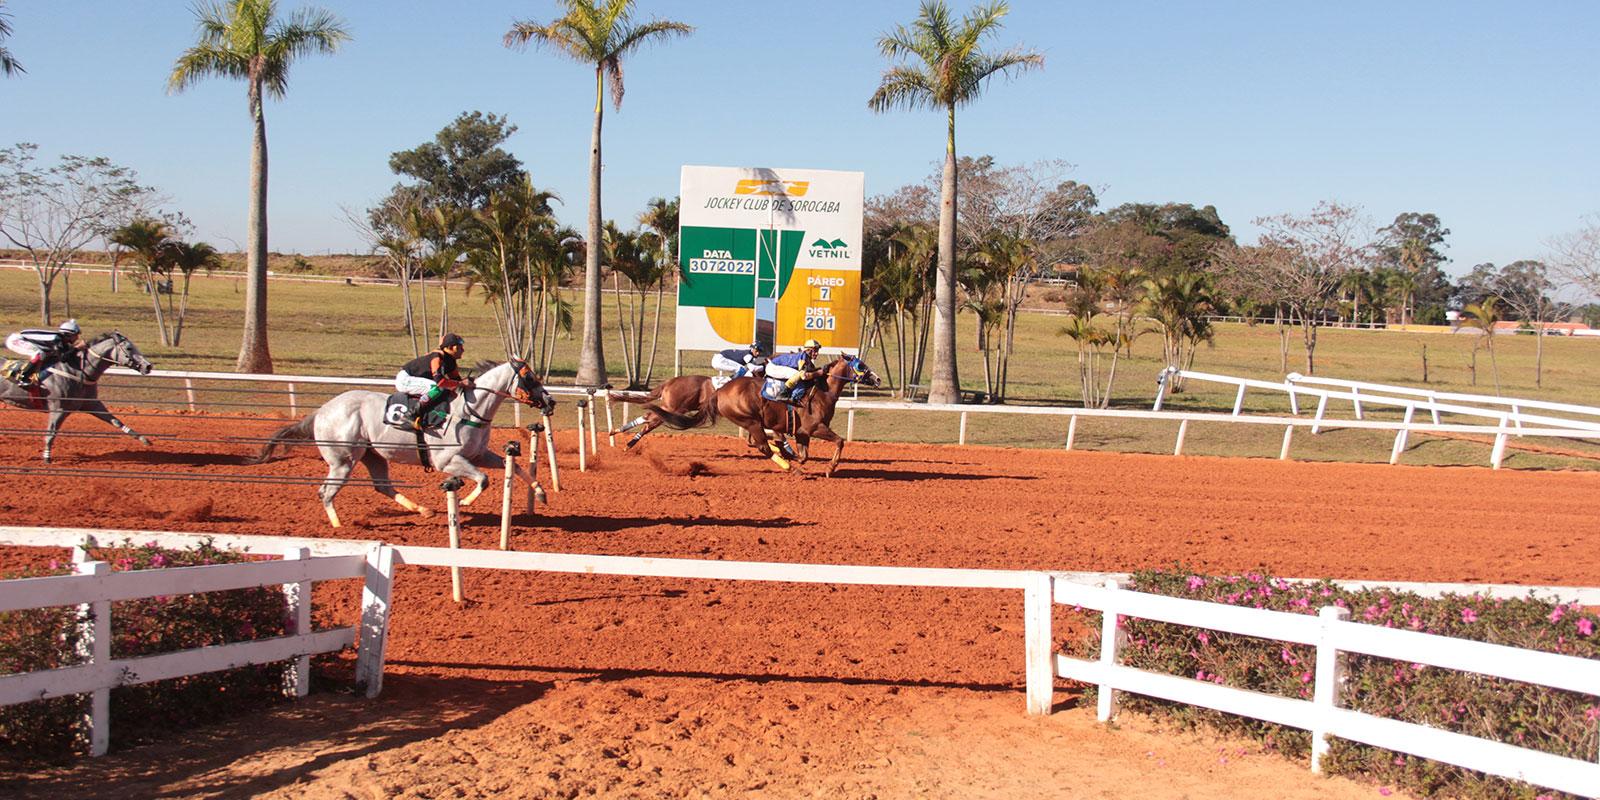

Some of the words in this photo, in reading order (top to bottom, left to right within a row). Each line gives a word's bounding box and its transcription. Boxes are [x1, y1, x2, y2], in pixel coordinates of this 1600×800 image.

[704, 197, 743, 209] JOCKEY
[743, 198, 769, 210] CLUB
[771, 199, 786, 211] DE
[787, 200, 840, 213] SOROCABA
[703, 249, 732, 259] DATA
[809, 249, 850, 259] VETNIL
[807, 275, 845, 287] PÁREO
[821, 288, 828, 299] 7
[806, 307, 832, 316] DIST.
[806, 317, 833, 329] 201
[386, 403, 408, 425] 6
